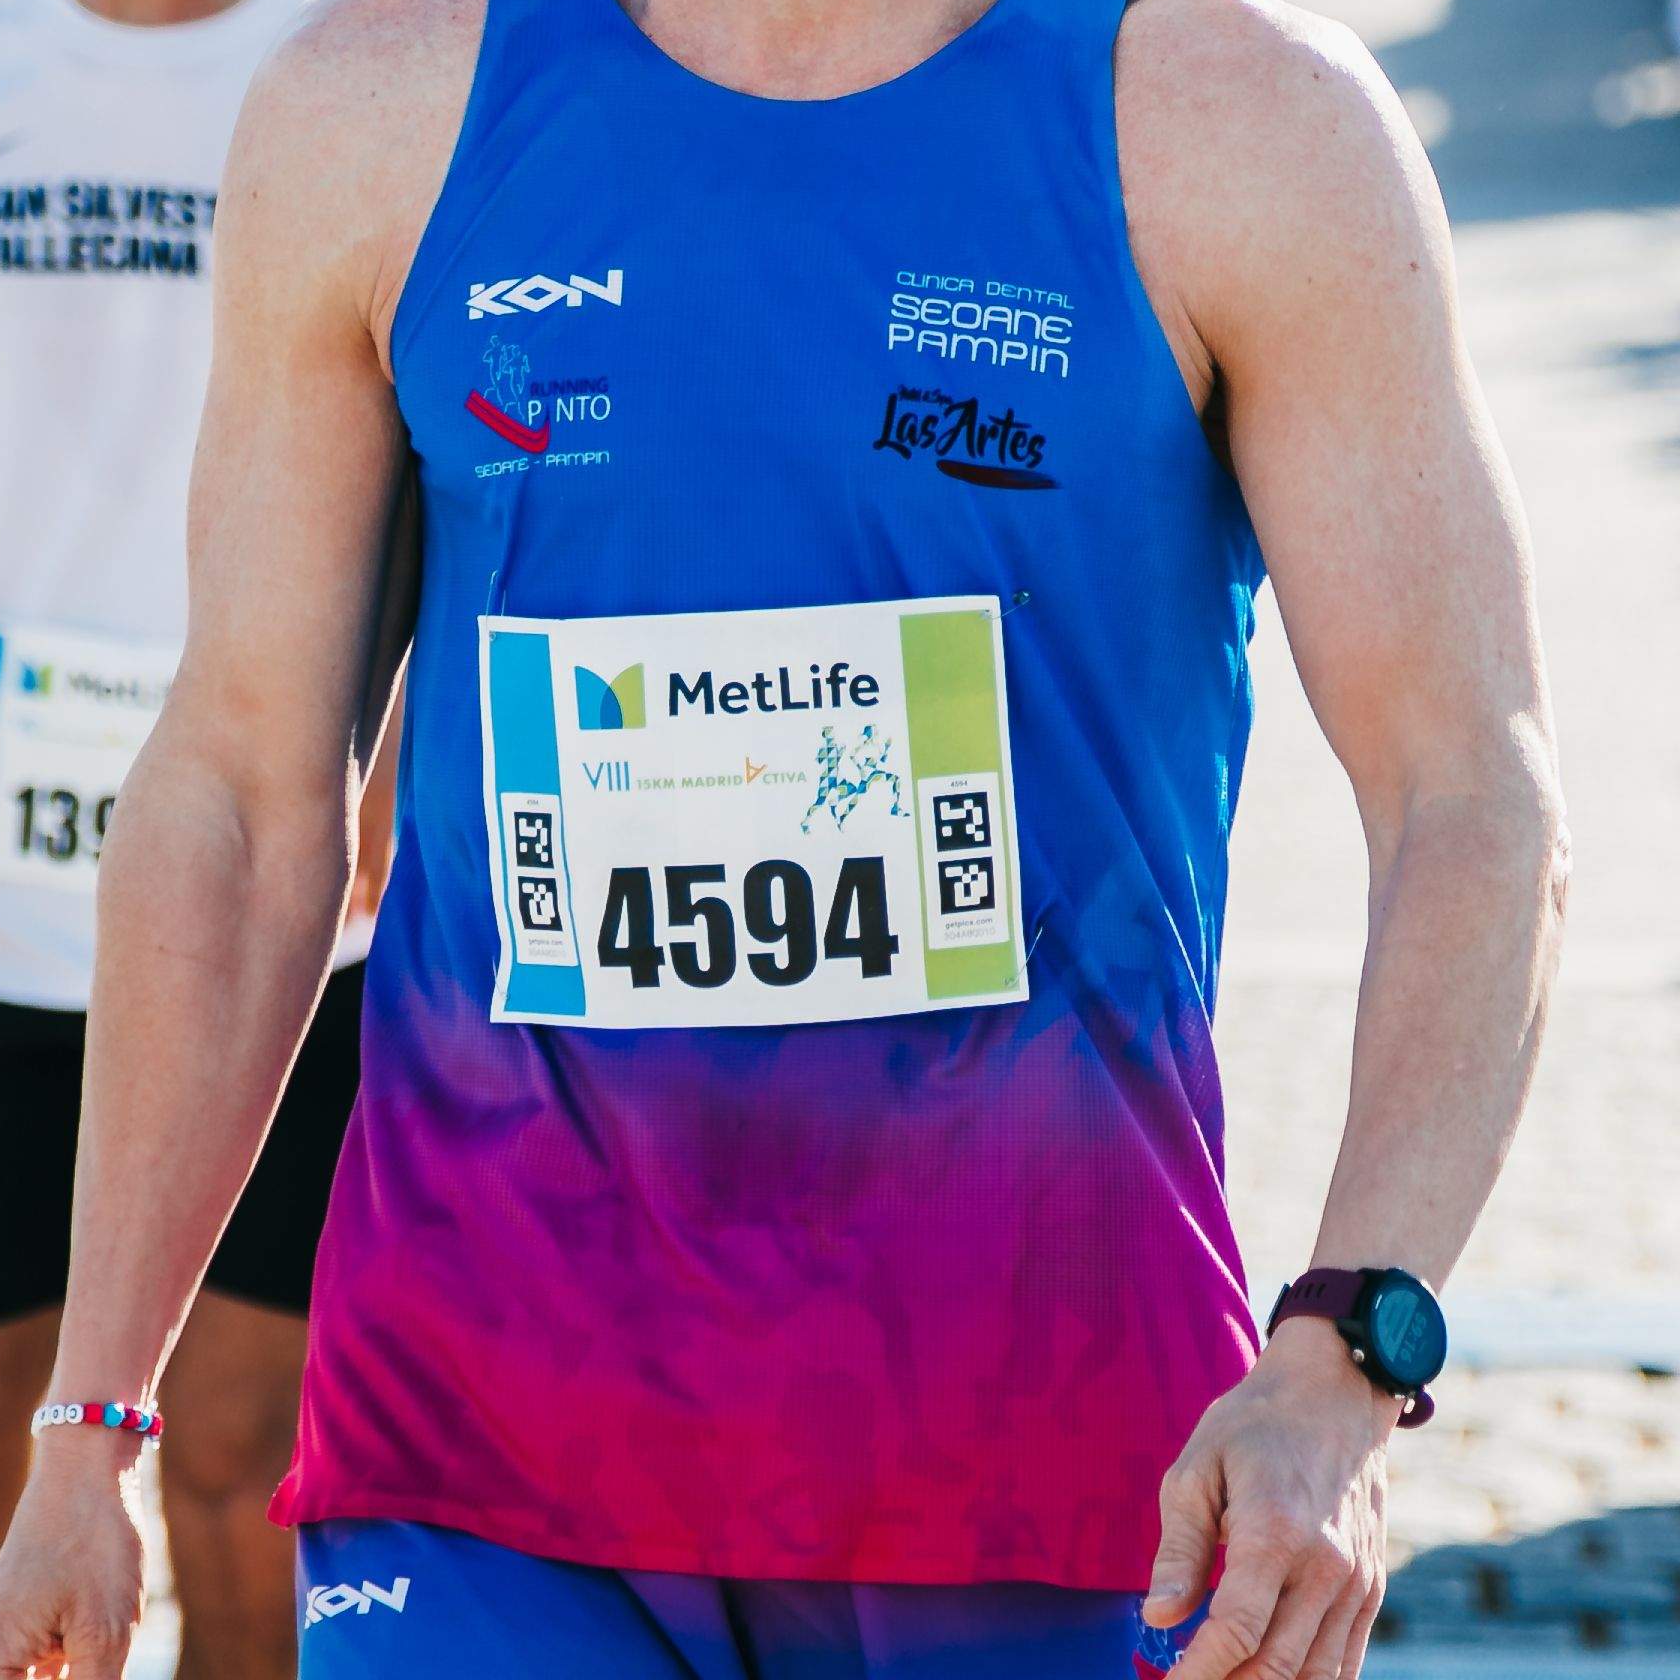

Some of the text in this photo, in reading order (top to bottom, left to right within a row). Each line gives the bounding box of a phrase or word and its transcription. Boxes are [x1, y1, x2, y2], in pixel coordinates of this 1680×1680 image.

[465, 269, 623, 320] KON
[896, 270, 1075, 310] CLINICA DENTAL
[890, 293, 1072, 345] SEOANE
[888, 323, 1069, 378] PAMPIN
[530, 376, 609, 398] RUNNING
[668, 662, 880, 717] MetLife
[582, 760, 630, 792] VIII
[637, 777, 676, 791] 15KM
[681, 774, 743, 789] MADRID
[597, 855, 900, 990] 4594
